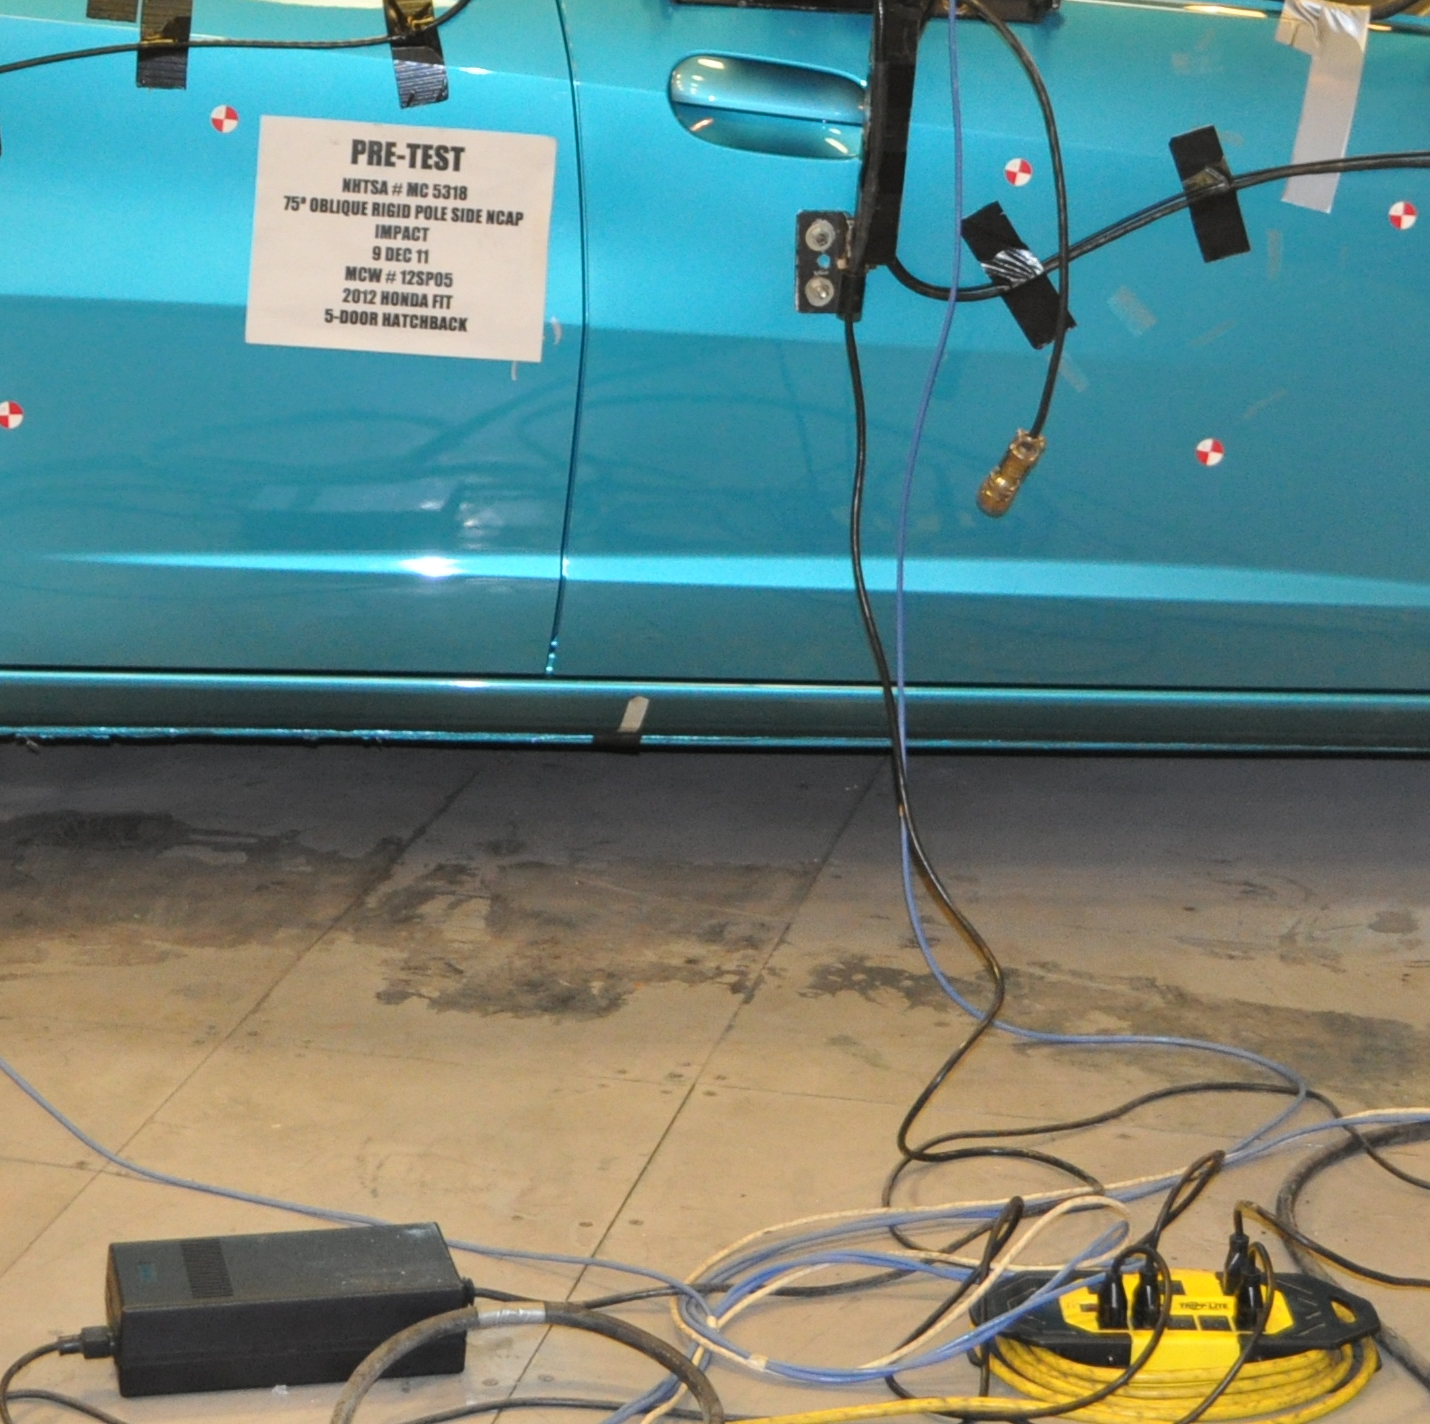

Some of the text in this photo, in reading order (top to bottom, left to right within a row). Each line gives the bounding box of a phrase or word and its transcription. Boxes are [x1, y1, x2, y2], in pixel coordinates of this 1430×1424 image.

[351, 139, 466, 172] PRE-TEST
[342, 177, 468, 201] NHTSA # MC 5318
[309, 197, 368, 216] OBLIQUE
[371, 202, 411, 219] RIGID
[414, 205, 447, 222] POLE
[451, 207, 483, 224] SIDE
[486, 209, 524, 227] NCAP
[374, 224, 430, 242] IMPACT
[372, 245, 430, 264] 9 DEC 11
[344, 266, 454, 288] MCW # 12SP05
[342, 288, 453, 310] 2012 HONDA FIT
[324, 308, 468, 332] 5-DOOR HATCHBACK
